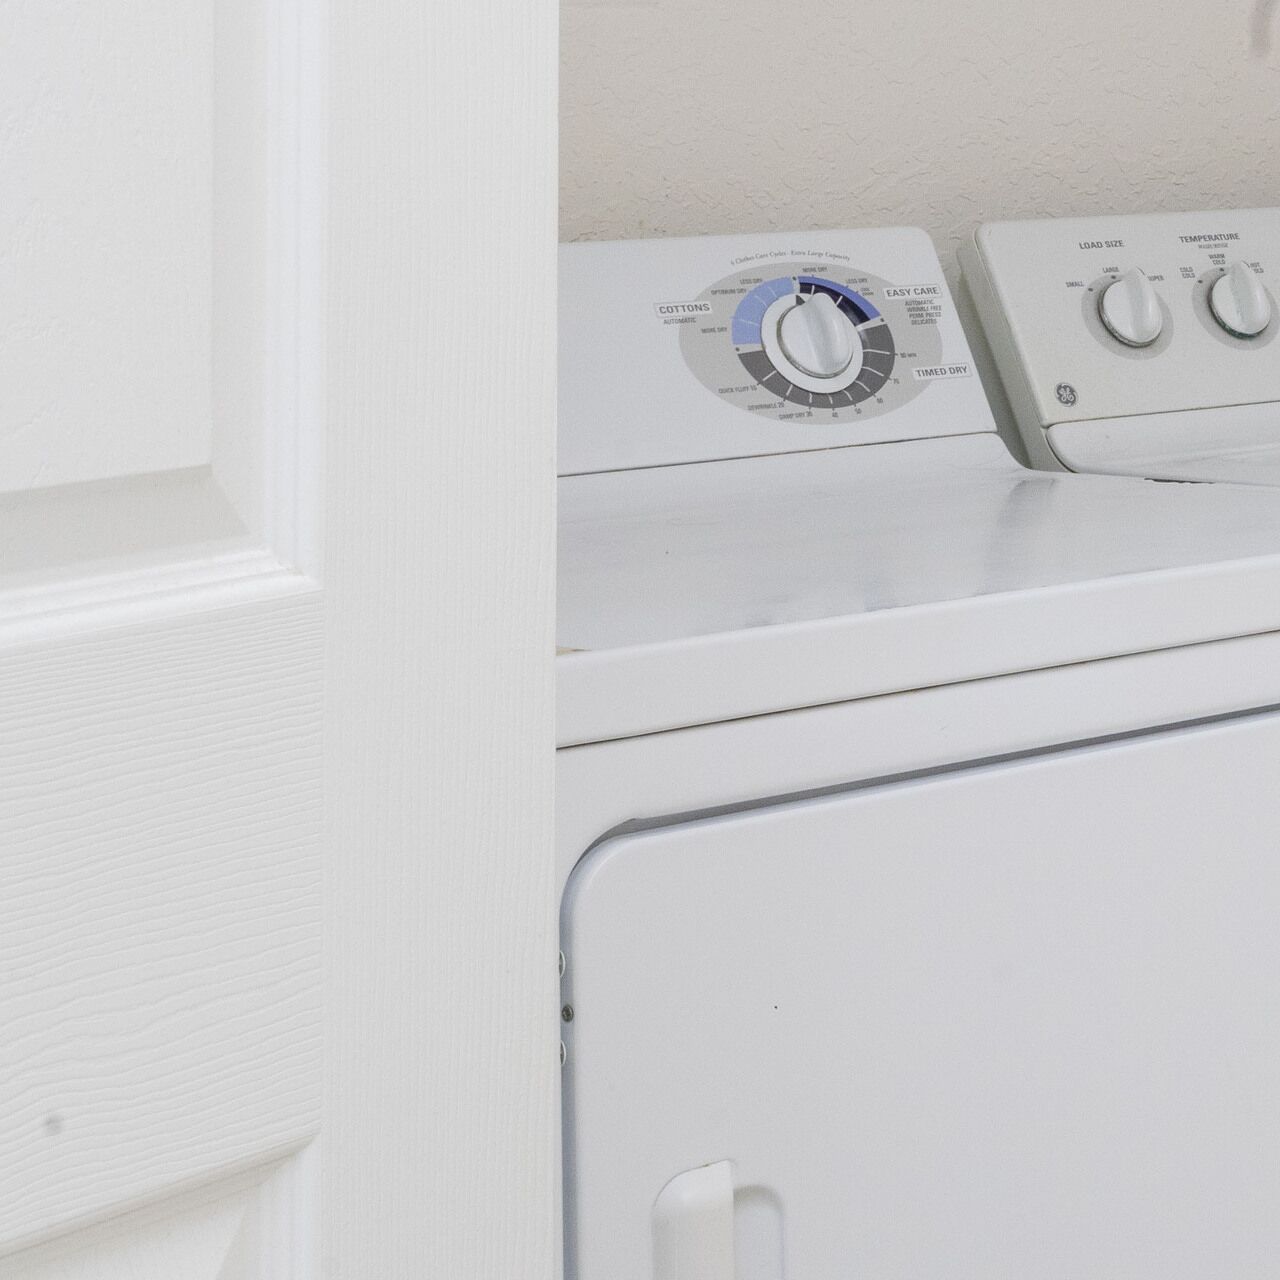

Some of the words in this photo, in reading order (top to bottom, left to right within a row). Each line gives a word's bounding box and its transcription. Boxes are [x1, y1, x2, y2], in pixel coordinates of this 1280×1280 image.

[1179, 233, 1240, 243] TEMPERATURE
[1079, 241, 1103, 249] LOAD
[1105, 240, 1124, 248] SIZE
[886, 289, 912, 297] EASY
[913, 287, 940, 295] CARE
[659, 303, 710, 314] COTTONS
[663, 317, 697, 325] AUTOMATIC
[915, 368, 946, 377] TIMED
[949, 366, 967, 375] DRY
